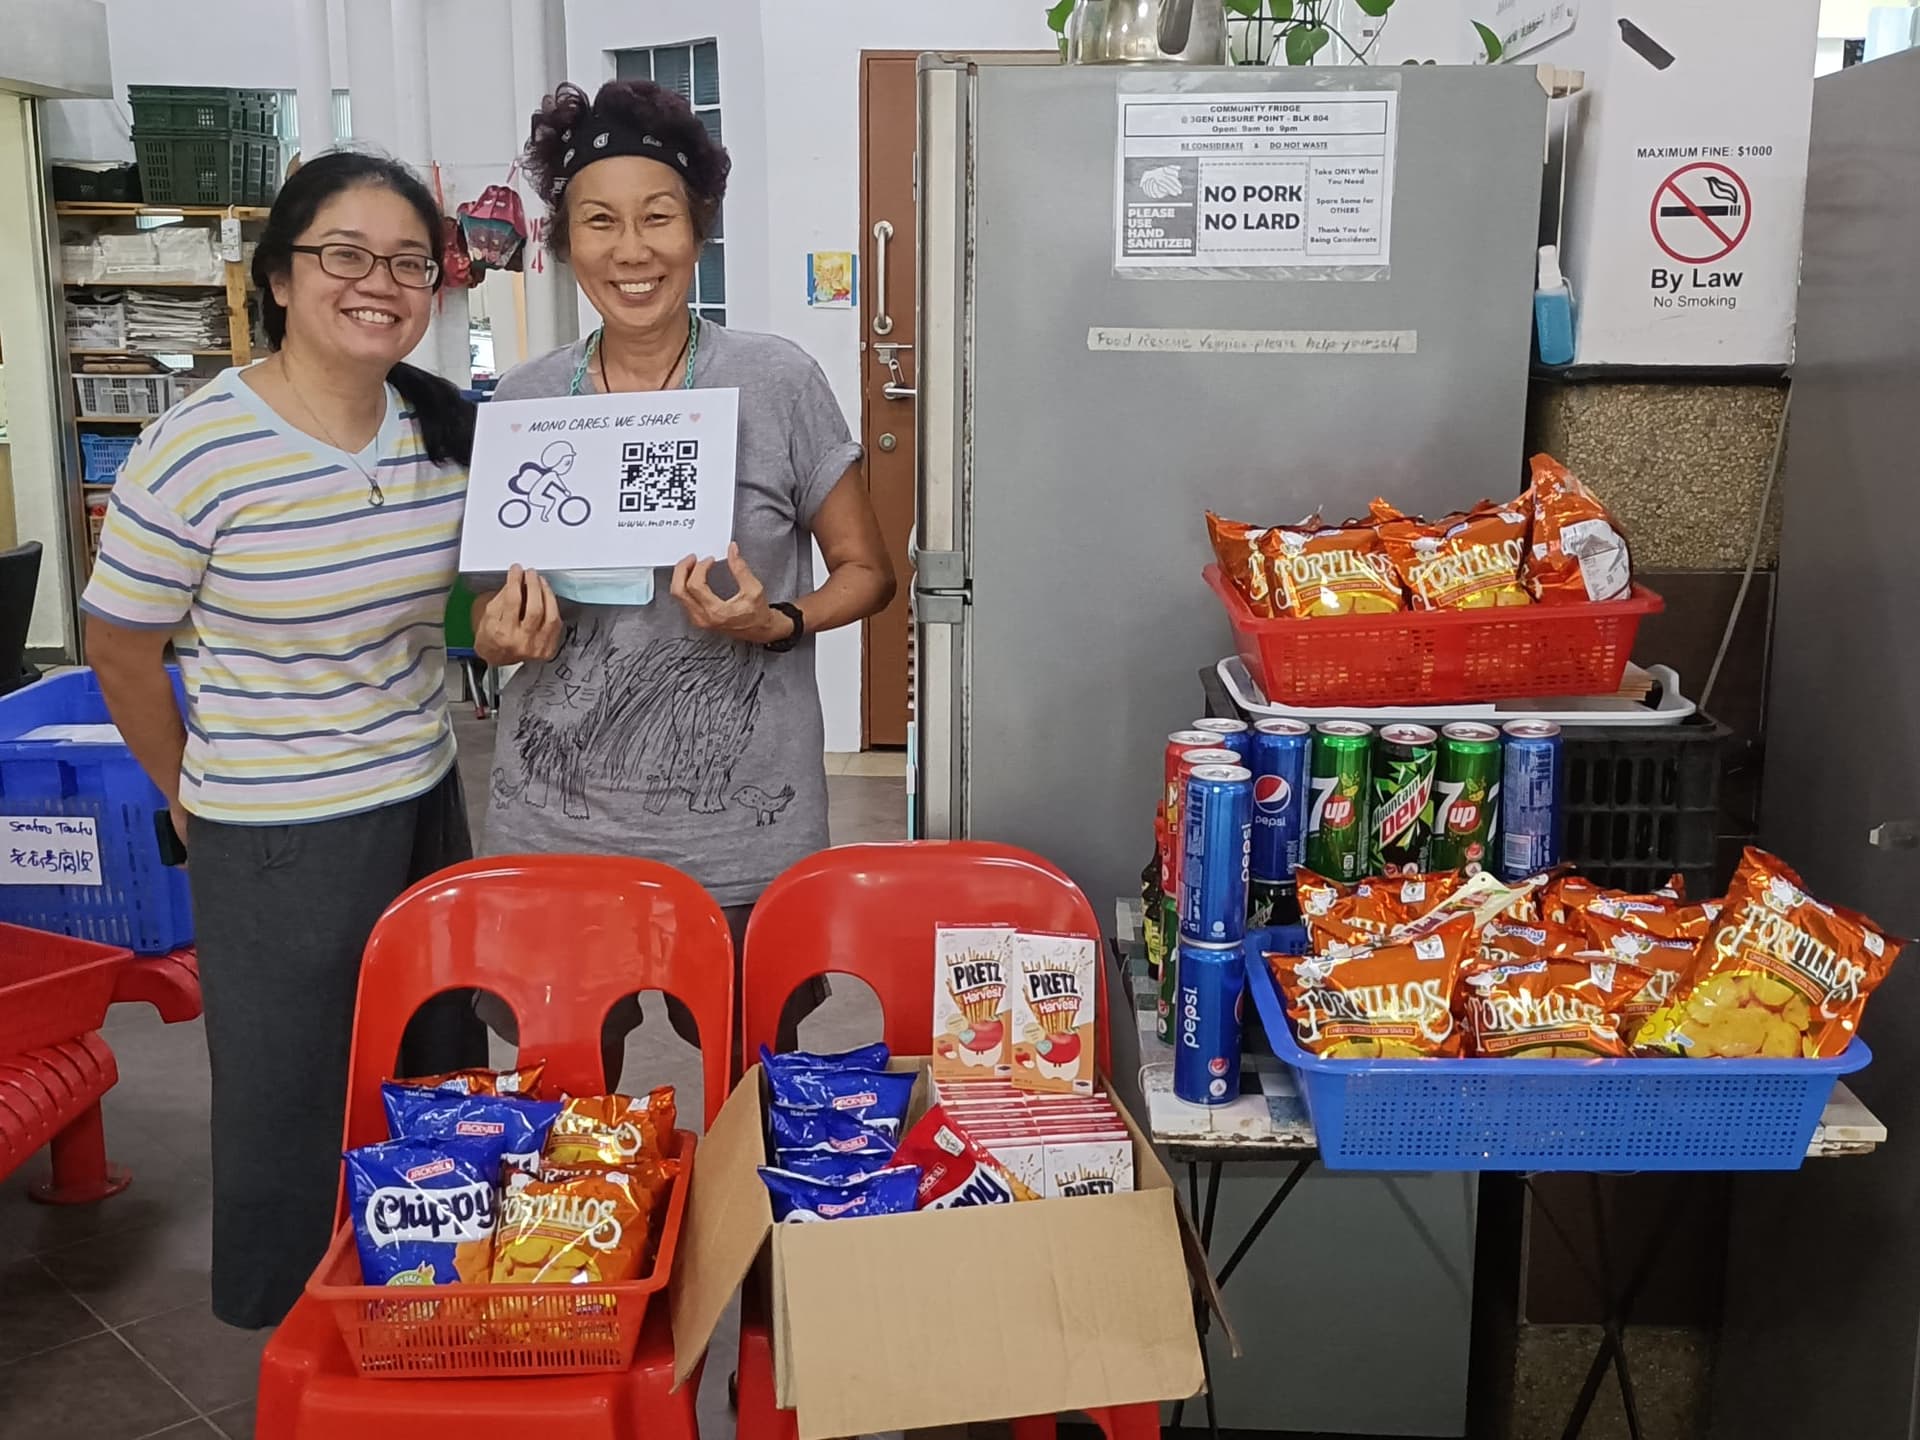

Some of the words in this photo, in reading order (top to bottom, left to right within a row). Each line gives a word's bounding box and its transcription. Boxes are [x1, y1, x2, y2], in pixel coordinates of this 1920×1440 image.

[1209, 105, 1265, 113] COMMUNITY
[1217, 115, 1255, 123] LEISURE
[1191, 142, 1244, 150] CONSIDERATE
[1637, 147, 1698, 158] MAXIMUM
[1702, 147, 1733, 157] FINE:
[1738, 145, 1773, 157] $1000
[1204, 186, 1237, 202] NO
[1243, 185, 1303, 202] PORK
[1127, 208, 1176, 218] PLEASE
[1127, 218, 1153, 228] USE
[1204, 214, 1237, 230] NO
[1243, 213, 1300, 230] LARD
[1127, 228, 1165, 238] HAND
[1127, 238, 1192, 248] SANITIZER
[1651, 268, 1684, 293] By
[1692, 268, 1743, 288] Law
[1654, 296, 1672, 308] No
[1677, 295, 1737, 309] Smoking
[1097, 333, 1131, 347] Food
[528, 419, 567, 433] MONO
[615, 415, 636, 427] WE
[640, 413, 682, 426] SHARE
[617, 518, 695, 530] www.mono.sg
[1372, 776, 1420, 830] Mountain
[1254, 815, 1287, 828] pepsi
[1715, 903, 1868, 1020] TORTILLOS
[953, 962, 1002, 990] PRETZ
[1028, 973, 1078, 999] PRETZ
[964, 985, 1002, 1004] Harvest
[1039, 999, 1078, 1014] Harvest
[1297, 978, 1454, 1044] TORTILLOS
[1182, 986, 1200, 1049] pepsi
[374, 1187, 496, 1238] Chippy
